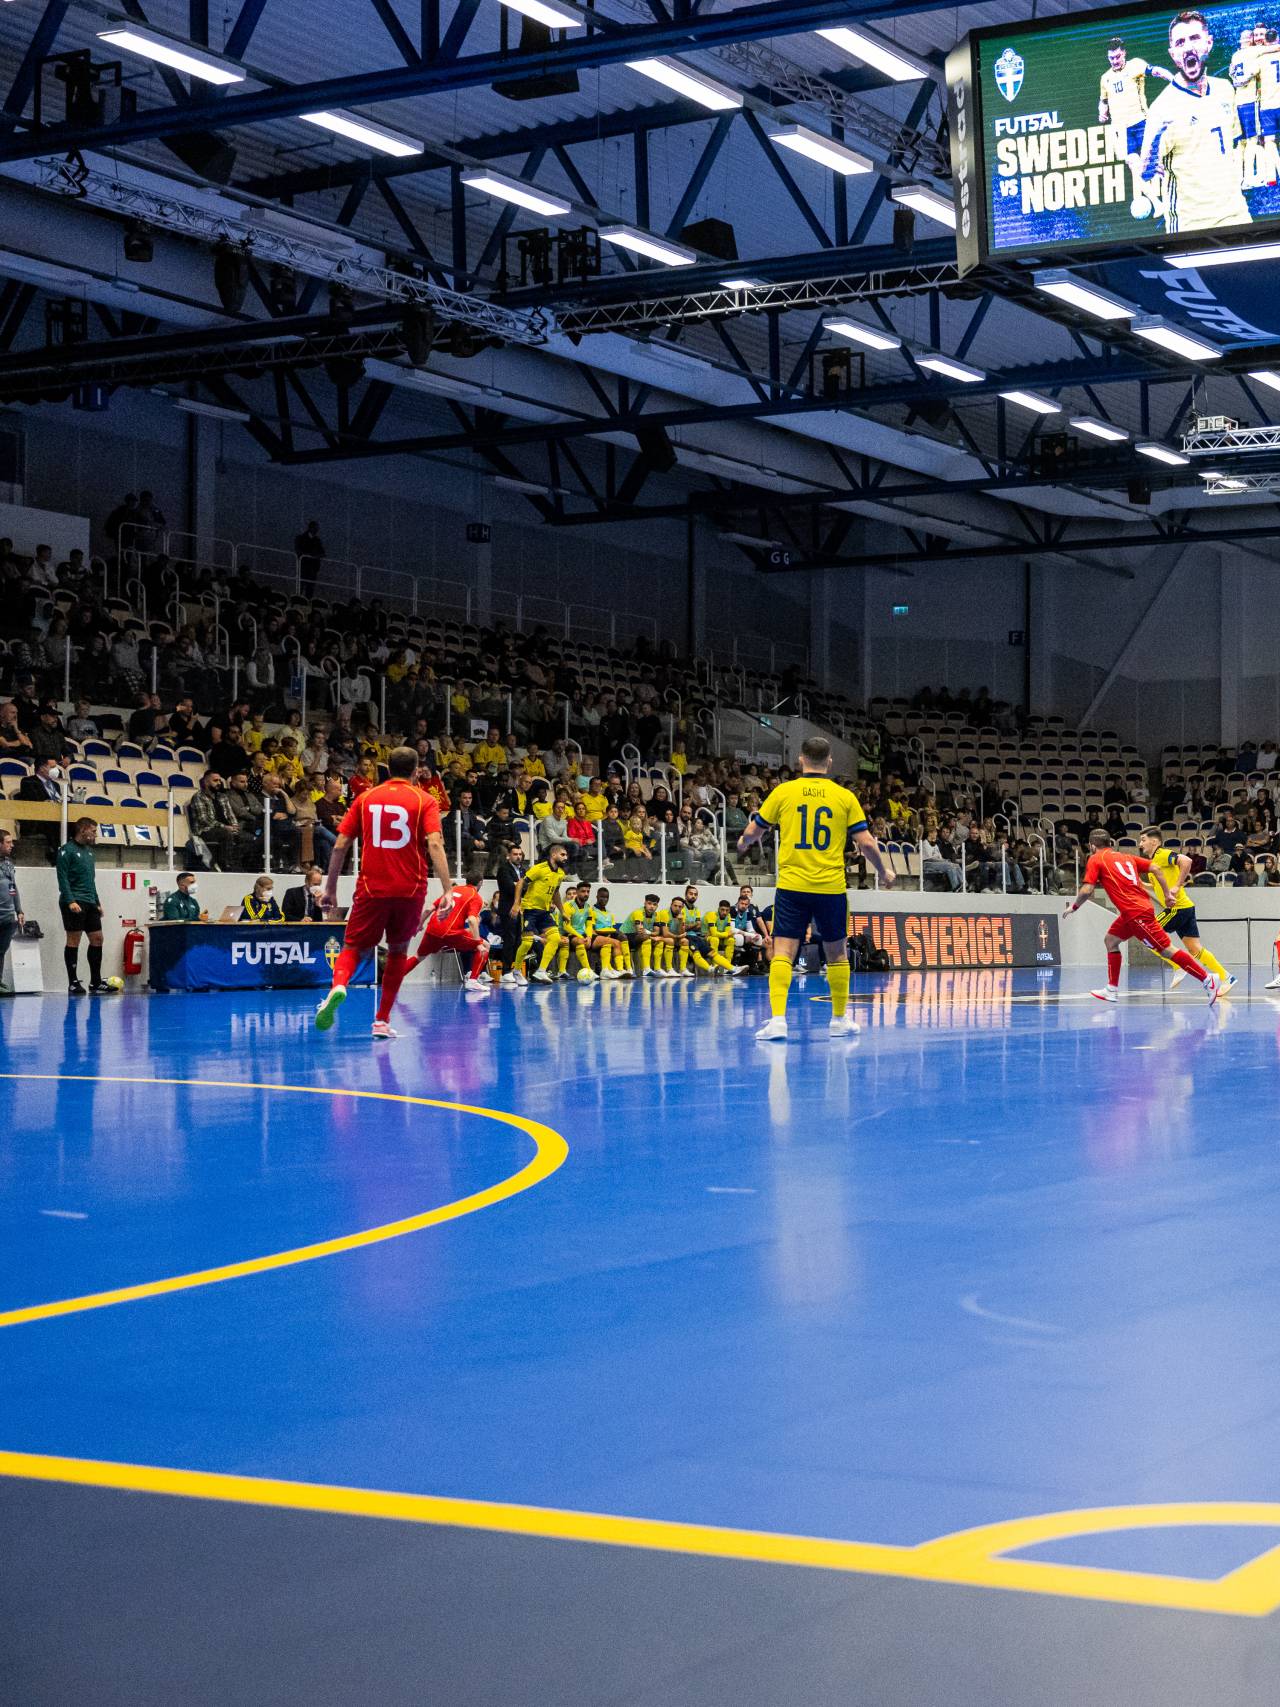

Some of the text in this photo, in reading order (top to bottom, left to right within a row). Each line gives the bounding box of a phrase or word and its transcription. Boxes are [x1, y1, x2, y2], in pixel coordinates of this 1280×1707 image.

[997, 123, 1128, 177] SWEDEN
[1021, 164, 1126, 215] NORTH
[802, 787, 826, 798] GASHI
[368, 803, 412, 850] 13
[794, 804, 833, 850] 16
[1114, 861, 1138, 886] 4
[231, 941, 317, 965] FUTSAL
[905, 914, 1013, 967] SVERIGE!
